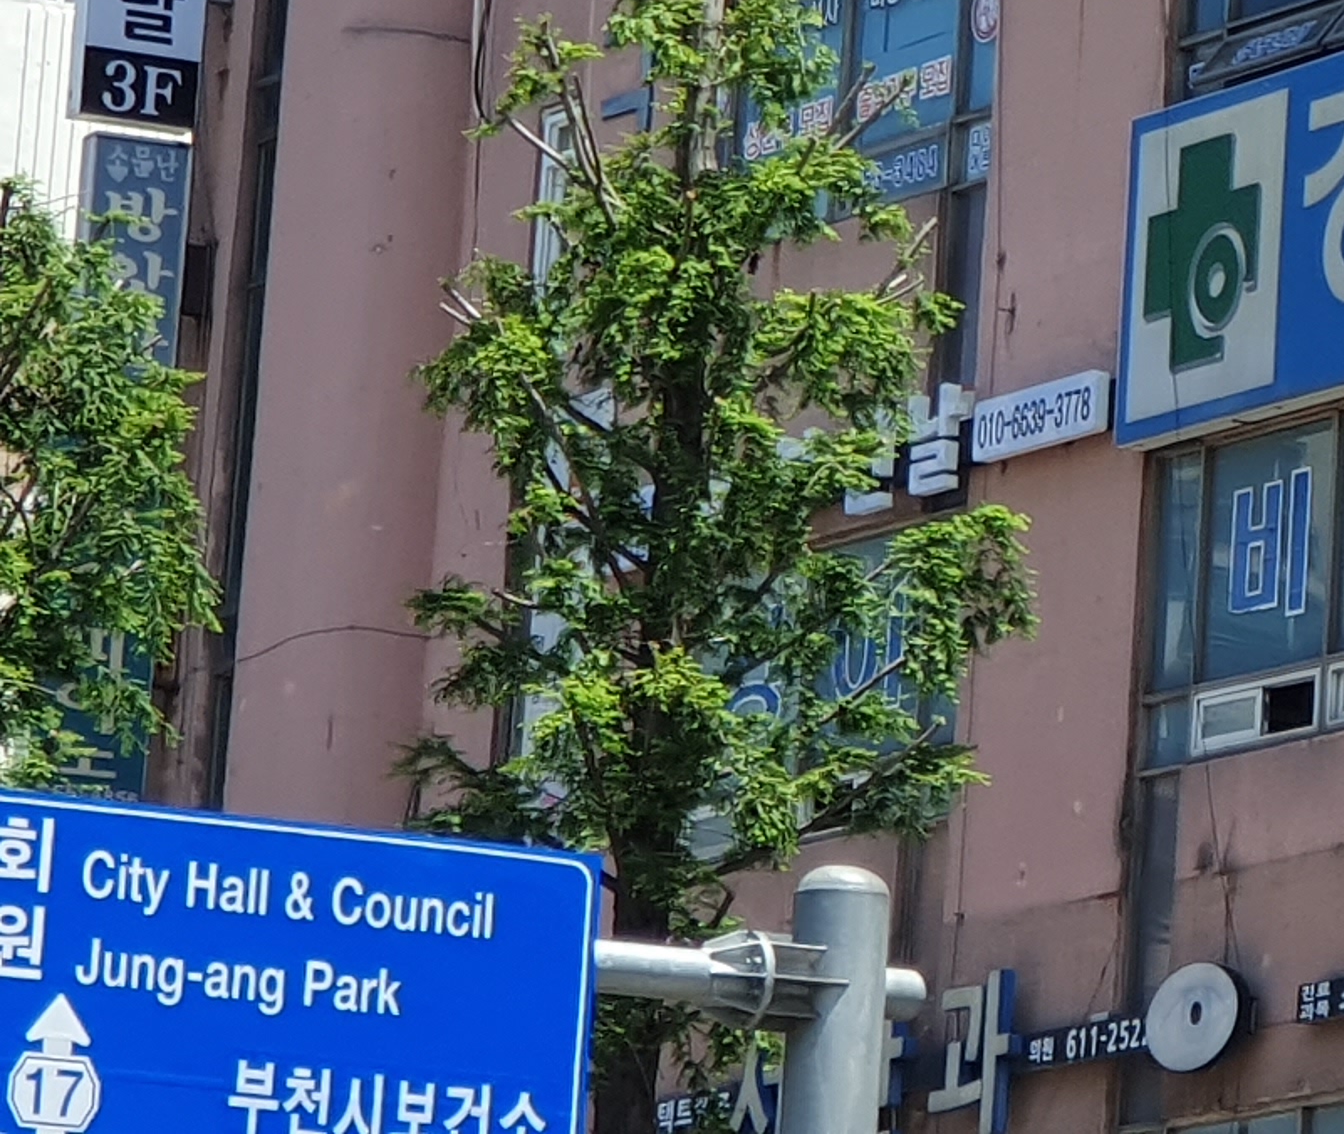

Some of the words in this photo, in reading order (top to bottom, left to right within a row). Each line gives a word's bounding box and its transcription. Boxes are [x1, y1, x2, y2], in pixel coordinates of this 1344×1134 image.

[101, 59, 183, 117] 3F
[81, 849, 169, 915] City
[186, 861, 270, 917] Hall
[284, 871, 315, 921] &
[331, 877, 496, 940] Council
[74, 938, 287, 1017] Jung-ang
[302, 960, 402, 1016] Park
[1065, 1018, 1148, 1060] 611-252
[24, 1068, 85, 1118] 17
